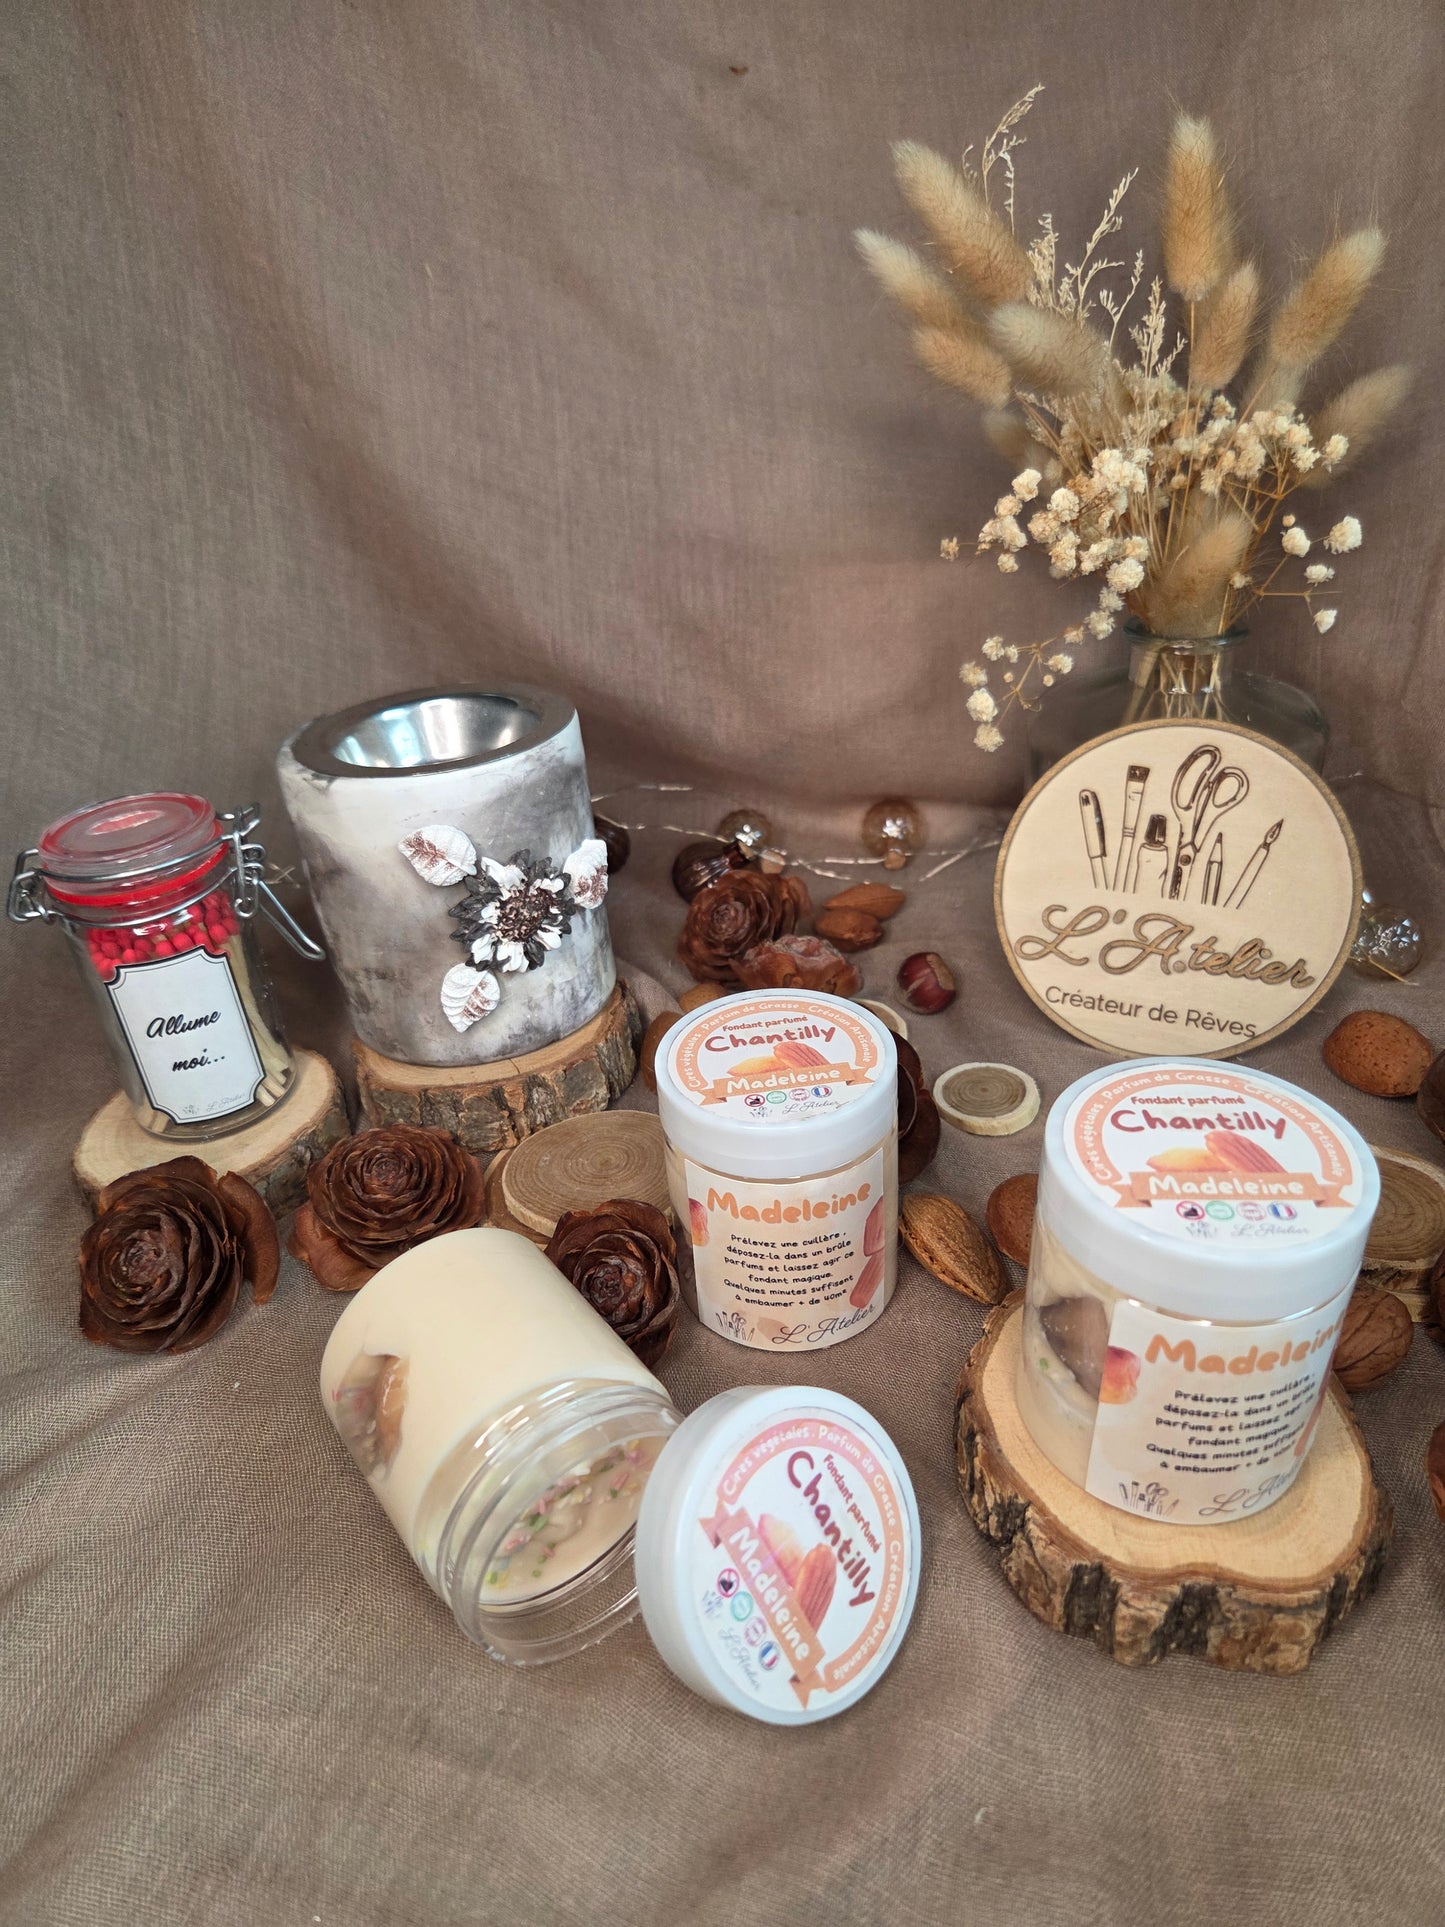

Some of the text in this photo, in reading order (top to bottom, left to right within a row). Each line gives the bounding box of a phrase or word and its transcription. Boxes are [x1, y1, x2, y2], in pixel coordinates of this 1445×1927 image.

[701, 1010, 741, 1030] Parfum
[742, 1005, 756, 1013] de
[758, 1002, 800, 1011] Grasse
[808, 1005, 851, 1027] Création
[1044, 984, 1258, 1039] Créateur de Rêves
[146, 1010, 221, 1038] Allume
[722, 1015, 808, 1032] Fondant parfumé
[704, 1024, 836, 1053] Chantilly
[726, 1069, 841, 1093] Madeleine
[1101, 1077, 1152, 1100] Parfum
[1154, 1073, 1171, 1082] de
[1175, 1072, 1230, 1085] Grasse
[1130, 1095, 1246, 1107] Fondant parfumé
[1110, 1109, 1287, 1140] Chantilly
[1149, 1174, 1304, 1196] Madeleine
[707, 1182, 871, 1224] Madeleine
[724, 1250, 855, 1272] parfums et laissez agir ce
[726, 1240, 852, 1260] déposez-la dans un brûle
[723, 1274, 854, 1296] Quelques minutes suffisent
[748, 1273, 789, 1284] fondant
[745, 1297, 795, 1307] embaumer
[808, 1297, 821, 1306] de
[1244, 1393, 1266, 1402] une
[1244, 1404, 1272, 1416] dans
[1155, 1416, 1213, 1434] parfums
[1218, 1424, 1234, 1432] et
[818, 1424, 861, 1459] Parfum
[1146, 1443, 1207, 1460] Quelques
[1212, 1447, 1259, 1460] minutes
[1188, 1436, 1242, 1447] fondant
[861, 1456, 875, 1474] de
[1174, 1463, 1241, 1473] embaumer
[823, 1453, 882, 1553] Fondant parfumé
[873, 1473, 896, 1526] Grasse
[787, 1450, 876, 1607] Chantilly
[882, 1540, 901, 1613] Création
[729, 1526, 810, 1661] Madeleine
